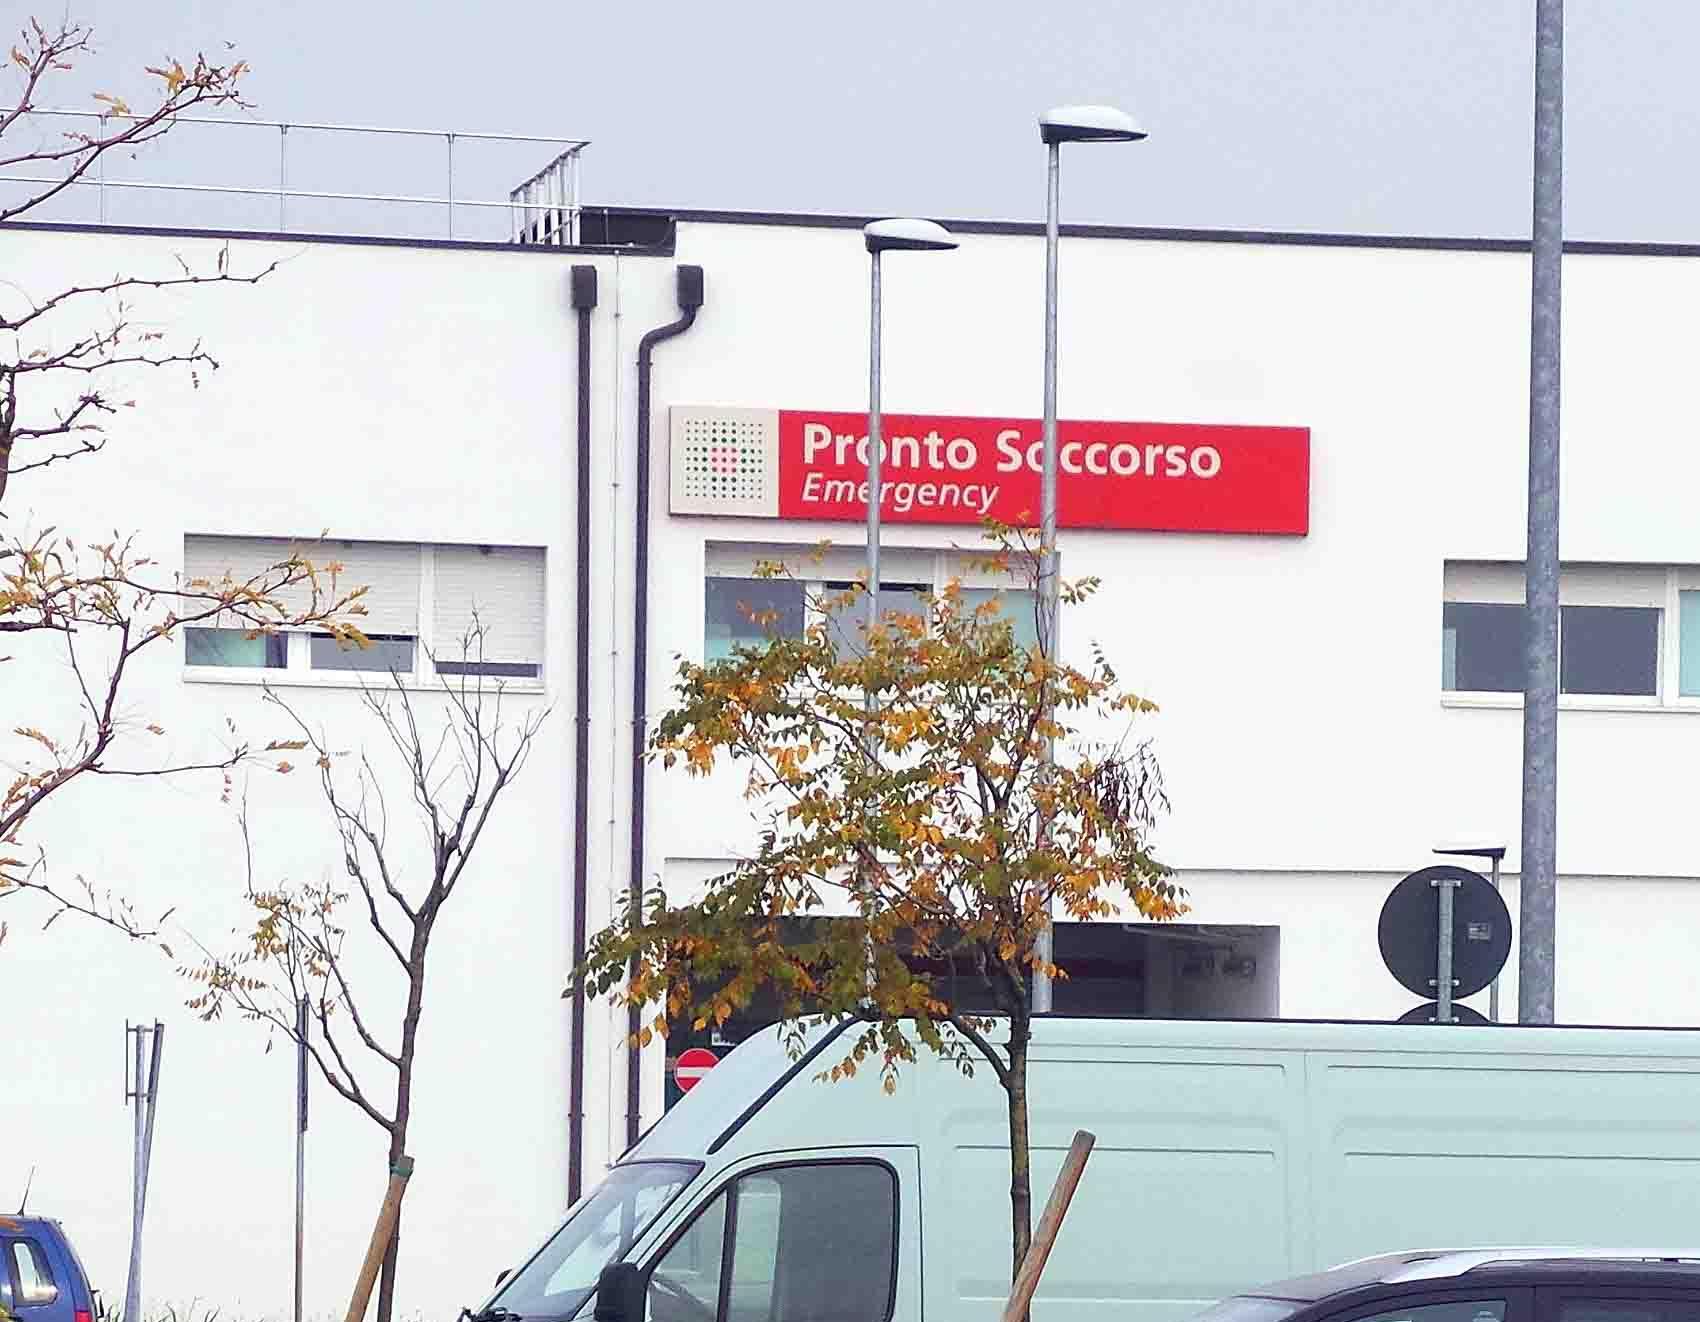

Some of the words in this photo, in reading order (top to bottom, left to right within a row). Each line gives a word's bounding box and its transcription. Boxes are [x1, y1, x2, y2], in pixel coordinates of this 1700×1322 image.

[803, 421, 978, 471] Pronto
[995, 429, 1222, 479] Soccorso
[802, 471, 1000, 515] Emergency
